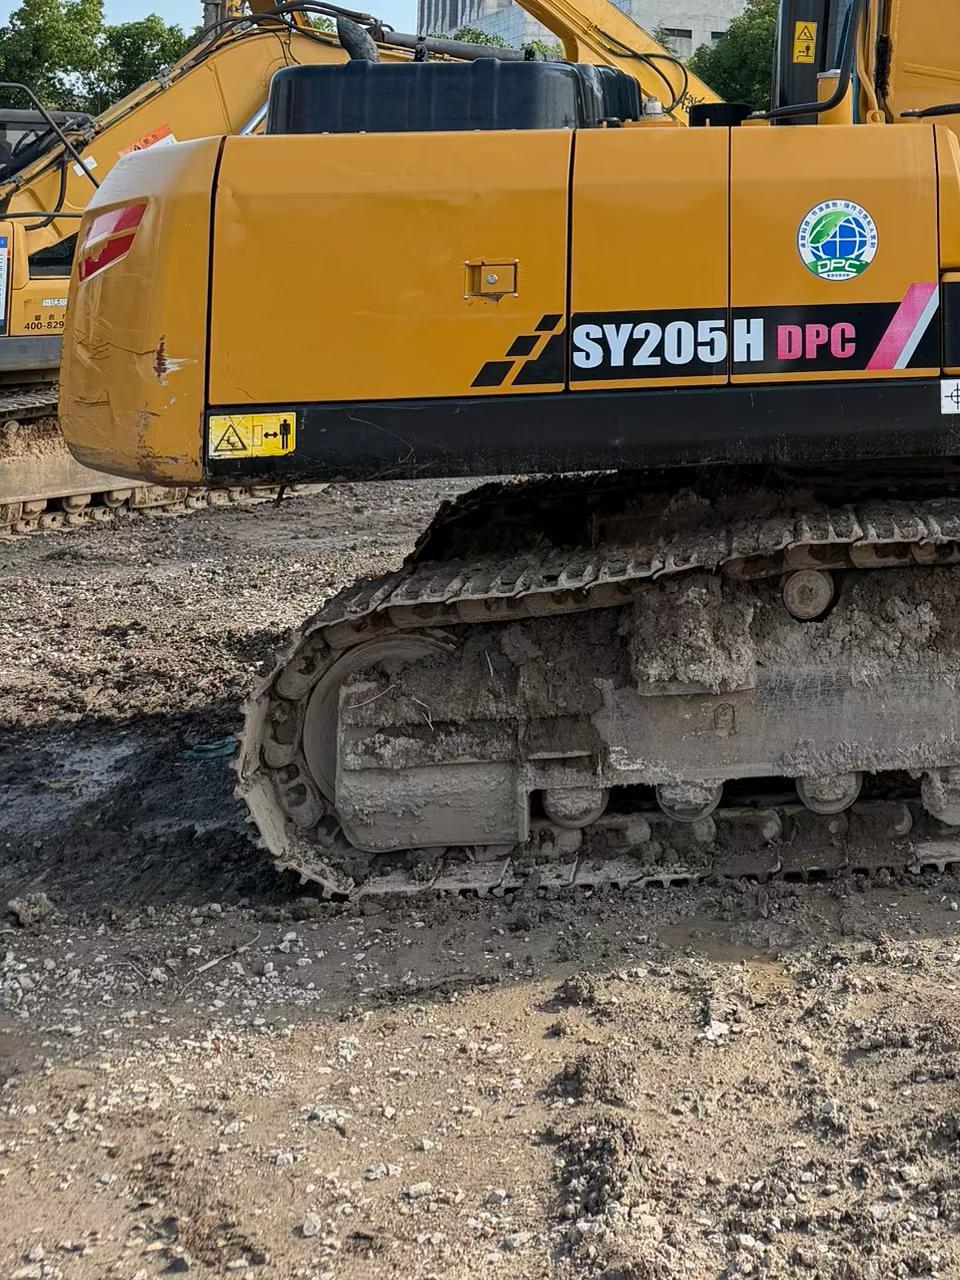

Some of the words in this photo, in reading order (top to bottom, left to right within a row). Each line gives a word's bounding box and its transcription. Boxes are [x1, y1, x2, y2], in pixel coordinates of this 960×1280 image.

[817, 259, 860, 273] DPC
[572, 318, 764, 368] SY205H
[776, 322, 856, 360] DPC
